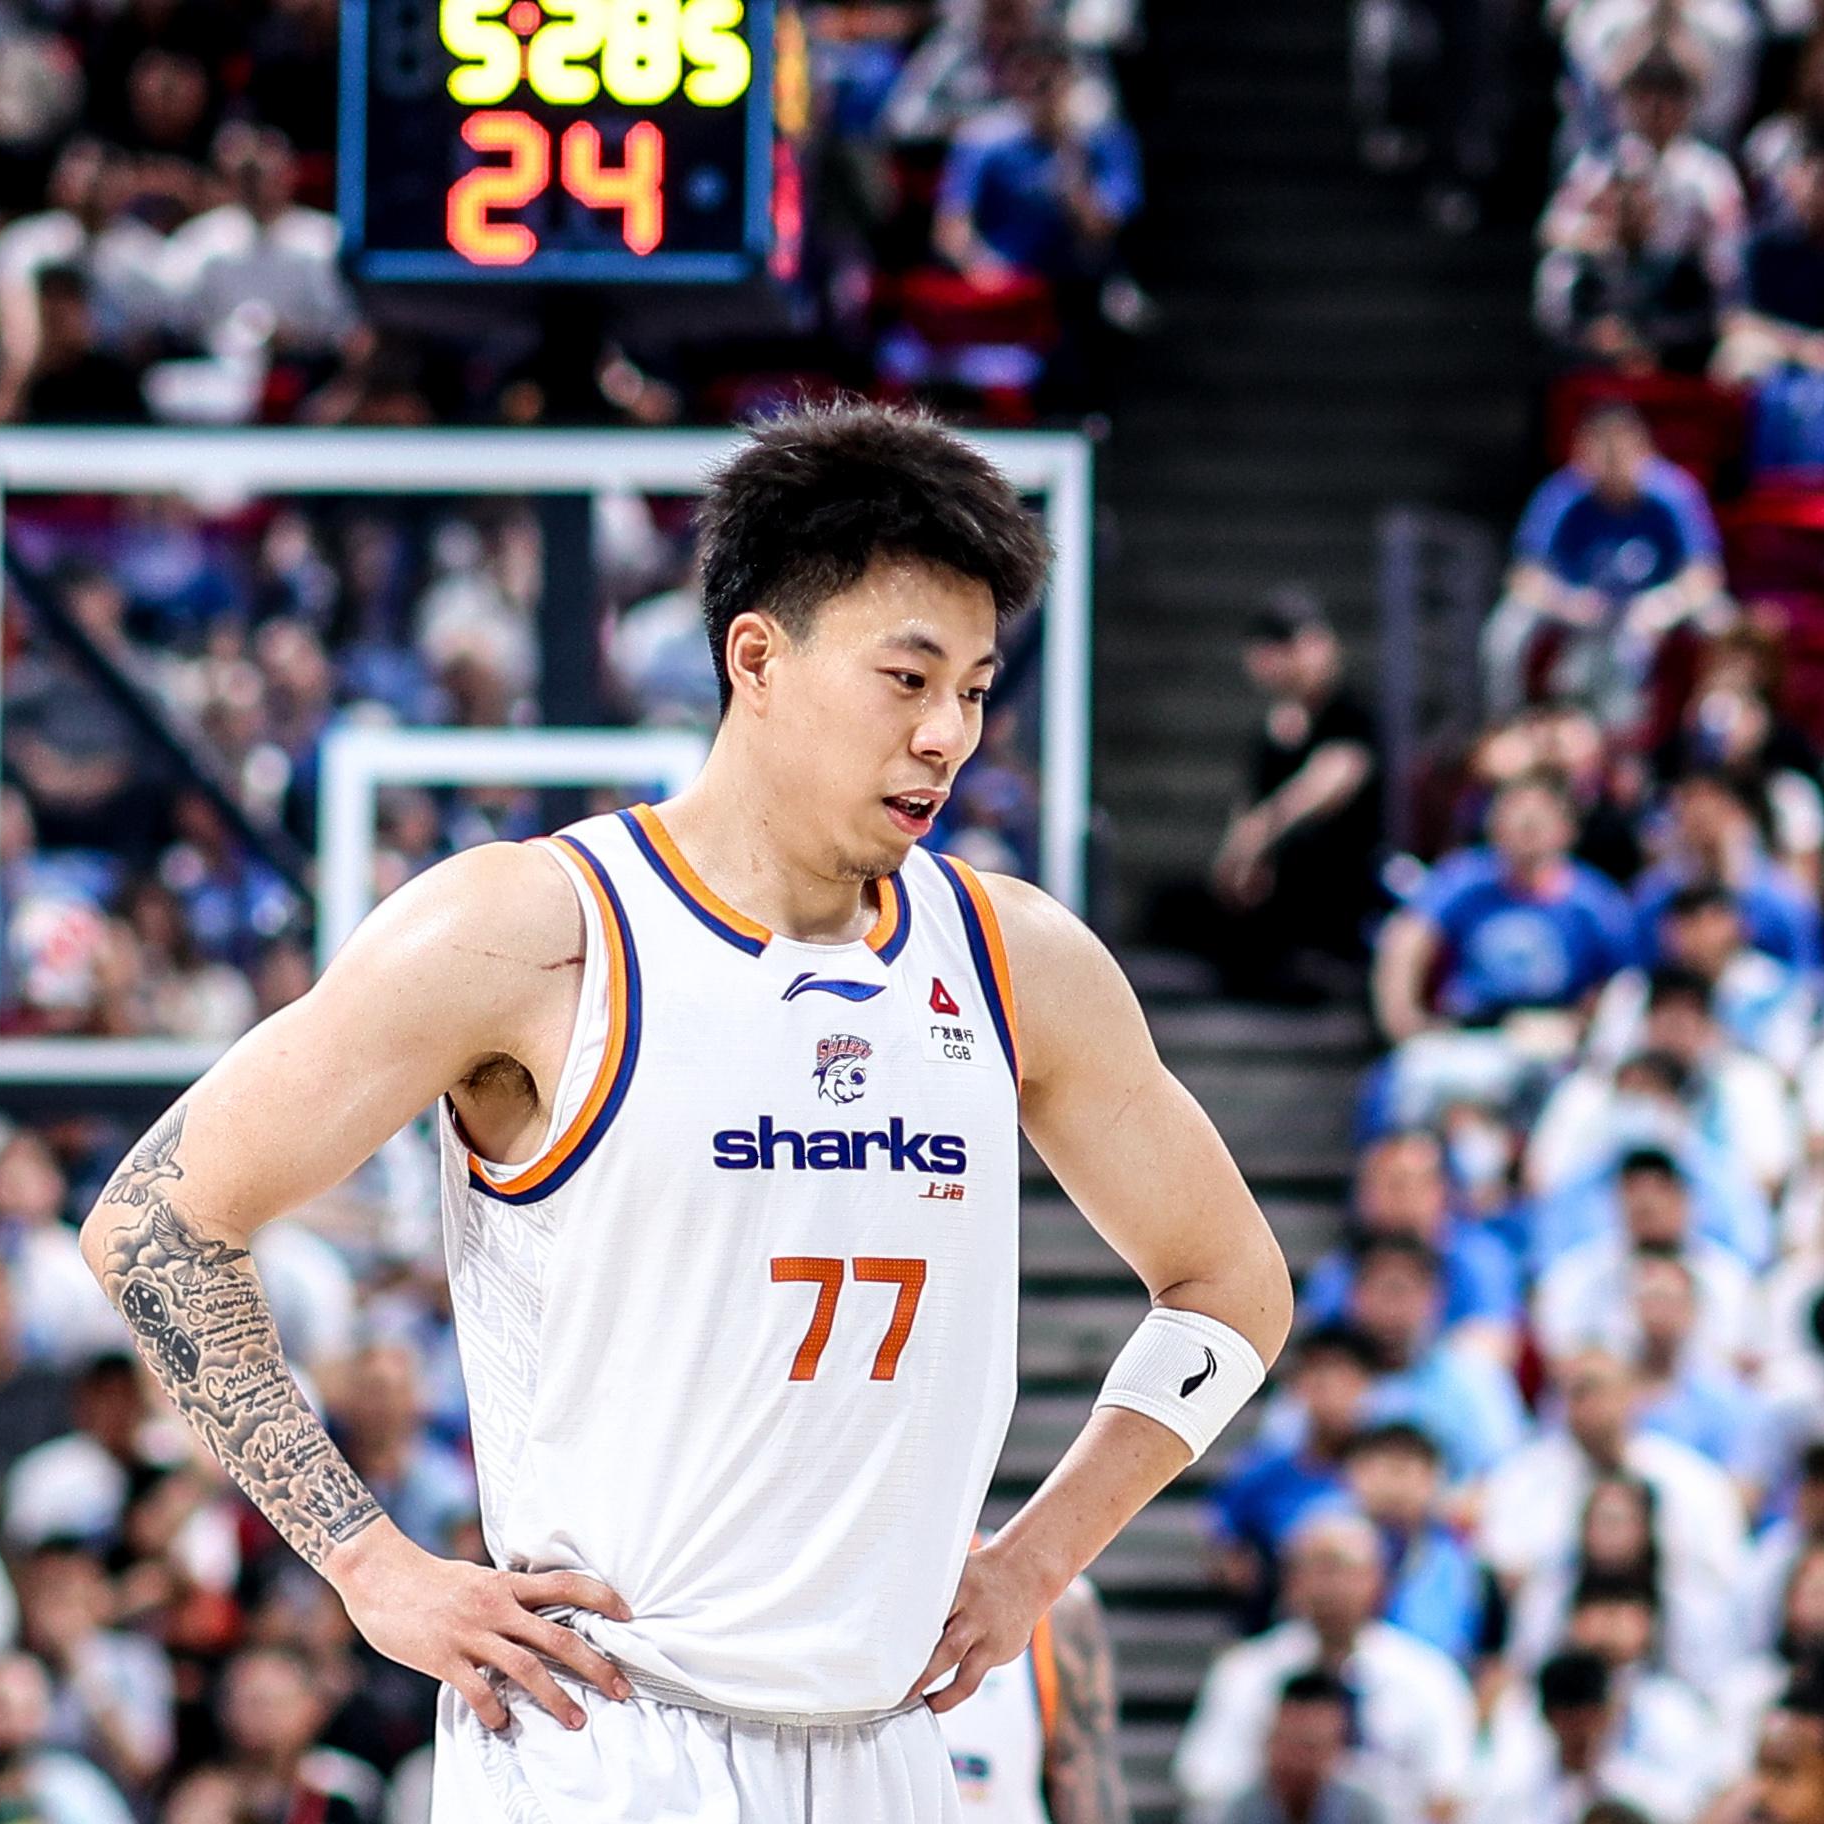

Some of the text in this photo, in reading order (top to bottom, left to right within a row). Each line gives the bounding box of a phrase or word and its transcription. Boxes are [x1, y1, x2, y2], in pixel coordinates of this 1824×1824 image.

[446, 110, 665, 265] 24
[930, 1025, 974, 1044] 广发银行
[943, 1043, 972, 1061] CGB
[713, 1116, 967, 1175] sharks
[918, 1181, 965, 1201] 上海
[770, 1257, 927, 1381] 77
